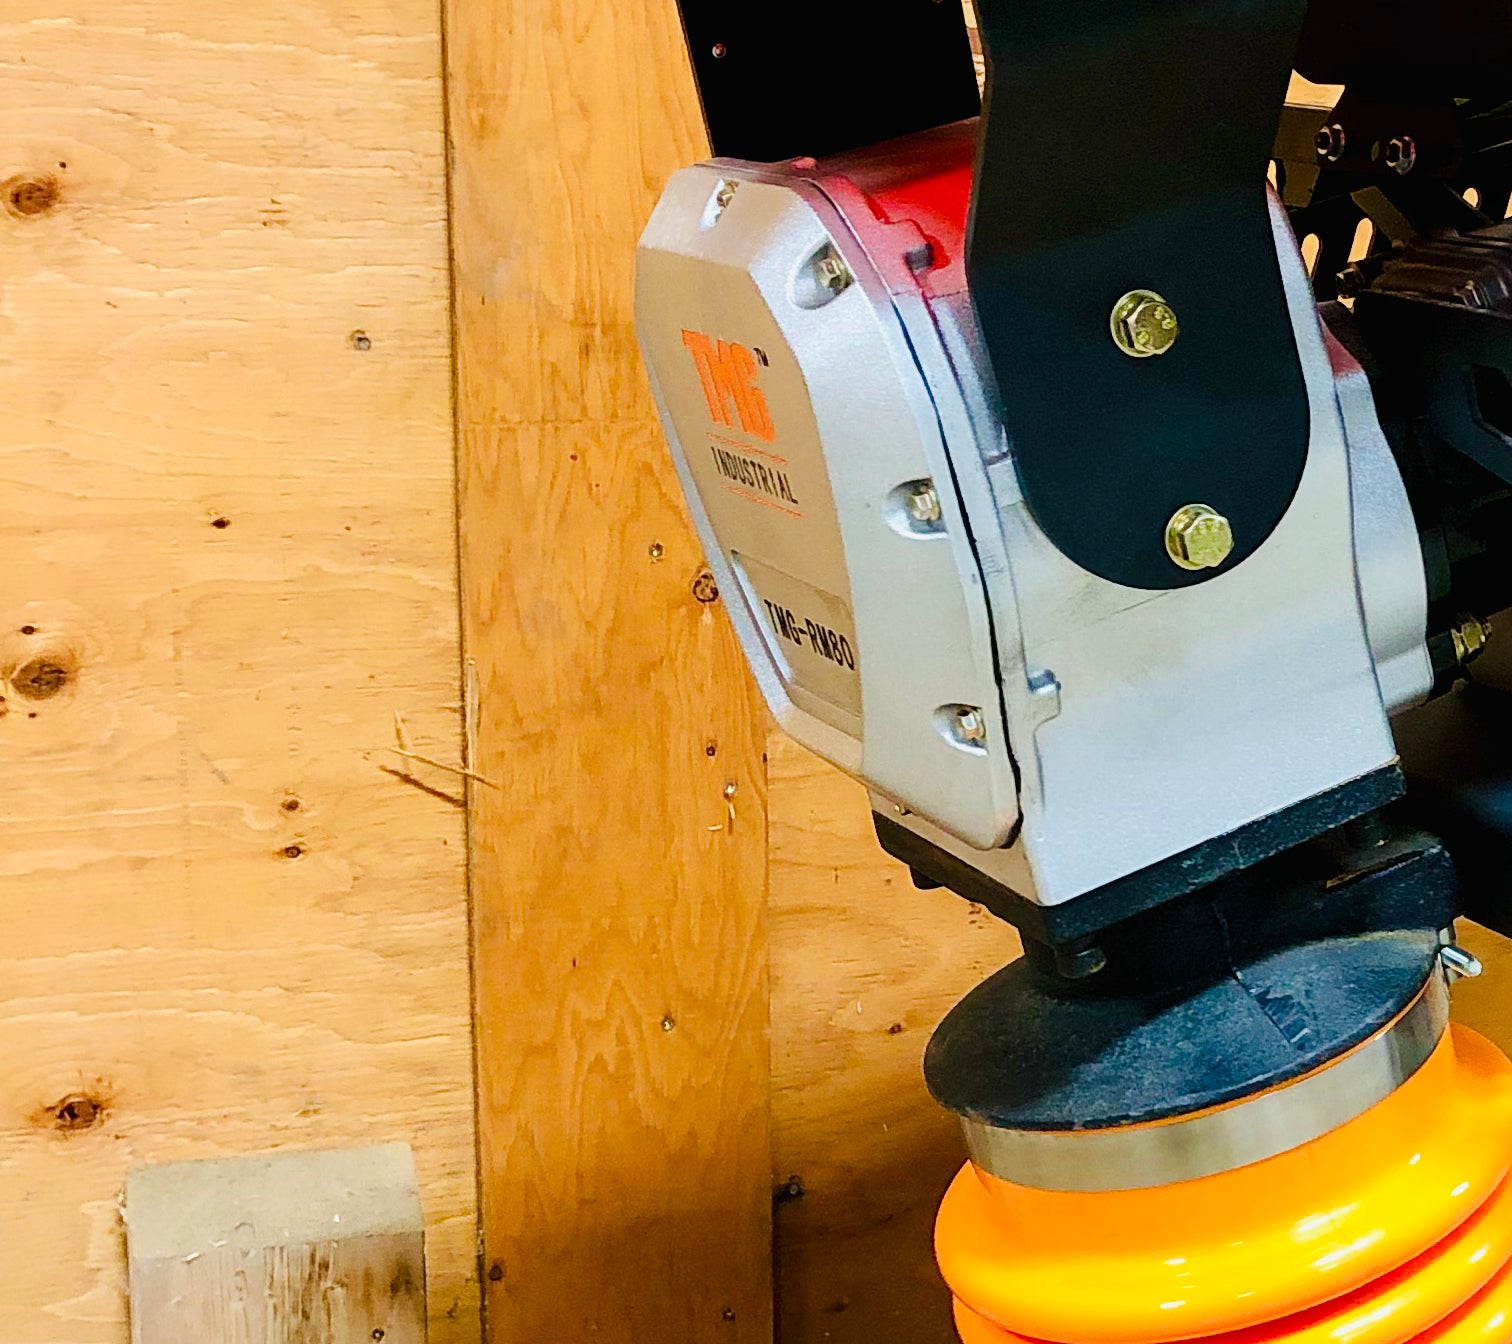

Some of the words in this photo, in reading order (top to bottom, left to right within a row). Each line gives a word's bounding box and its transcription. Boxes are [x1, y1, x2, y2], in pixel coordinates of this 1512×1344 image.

[681, 328, 776, 442] TMG
[711, 446, 799, 504] INDUSTRIAL
[764, 599, 855, 670] TMG-RM80
